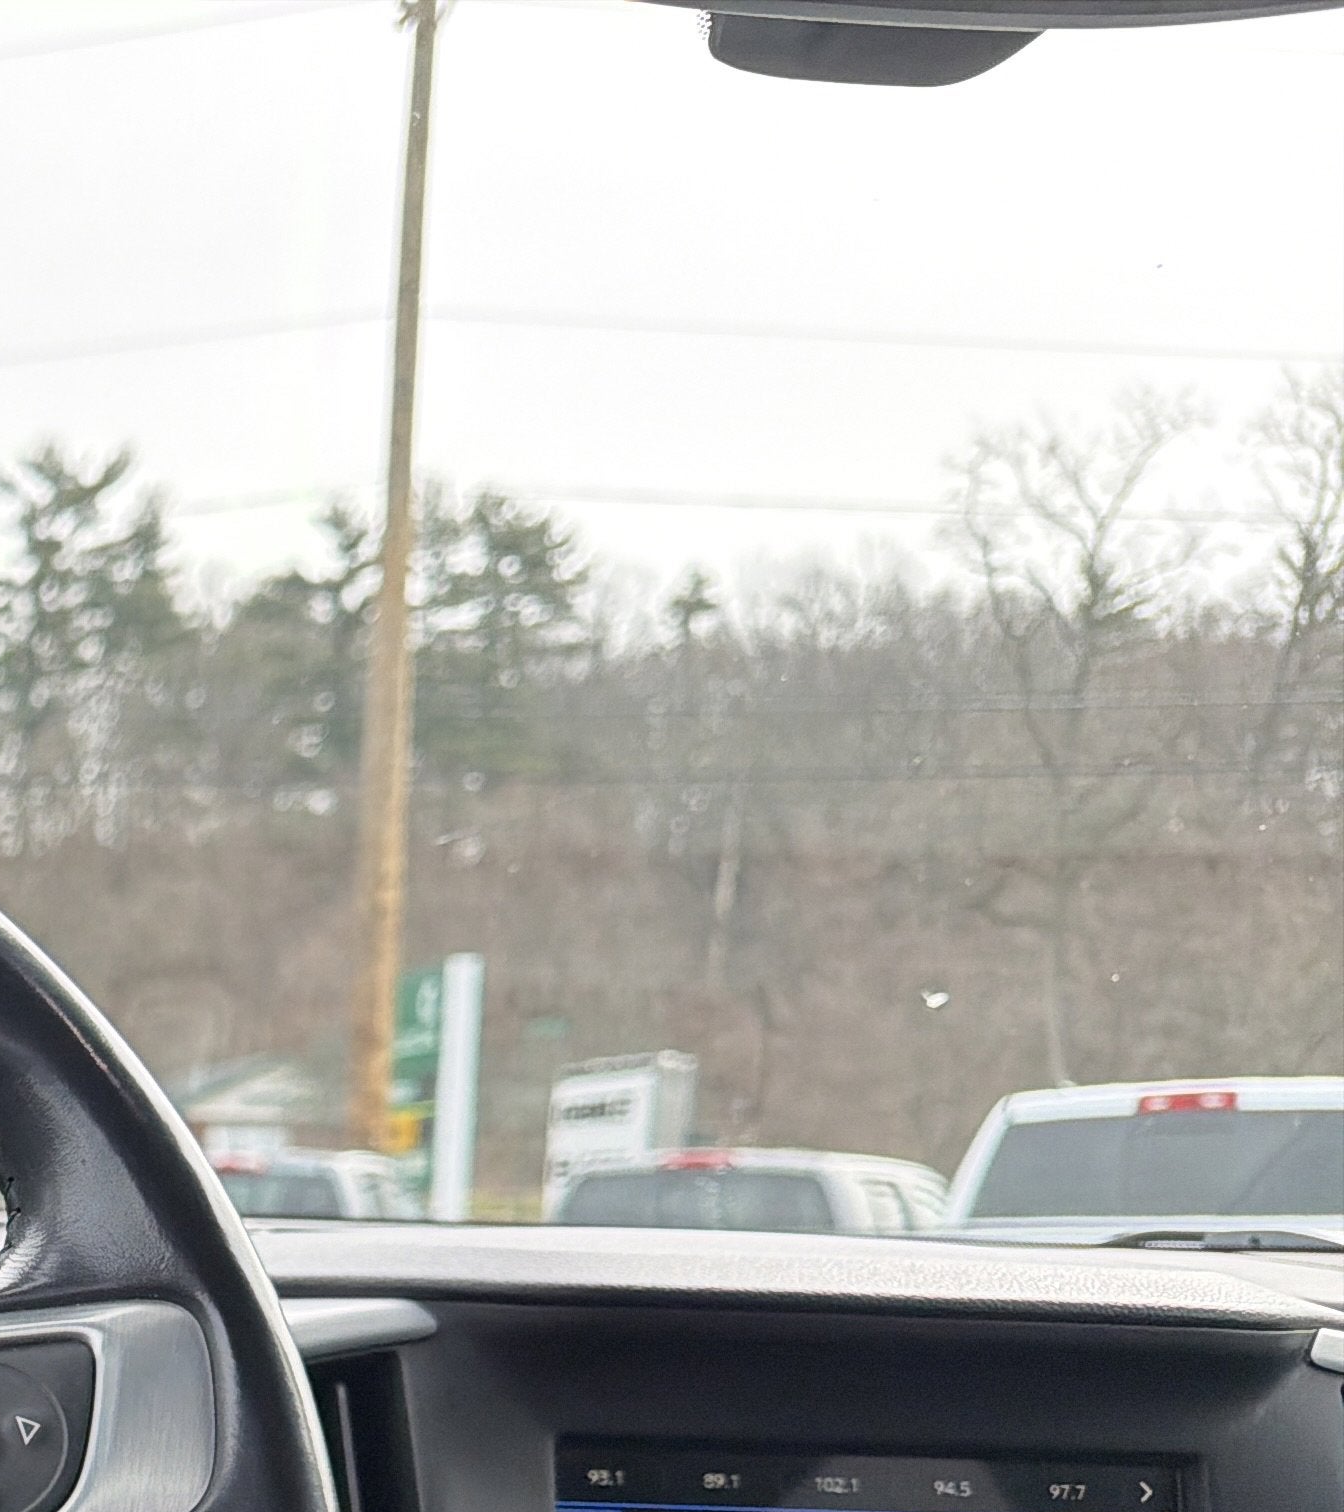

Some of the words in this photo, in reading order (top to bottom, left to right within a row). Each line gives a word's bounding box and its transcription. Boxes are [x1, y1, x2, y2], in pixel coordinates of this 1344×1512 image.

[814, 1477, 859, 1494] 102.1
[933, 1480, 972, 1498] 94.5
[1049, 1484, 1086, 1500] 97.7
